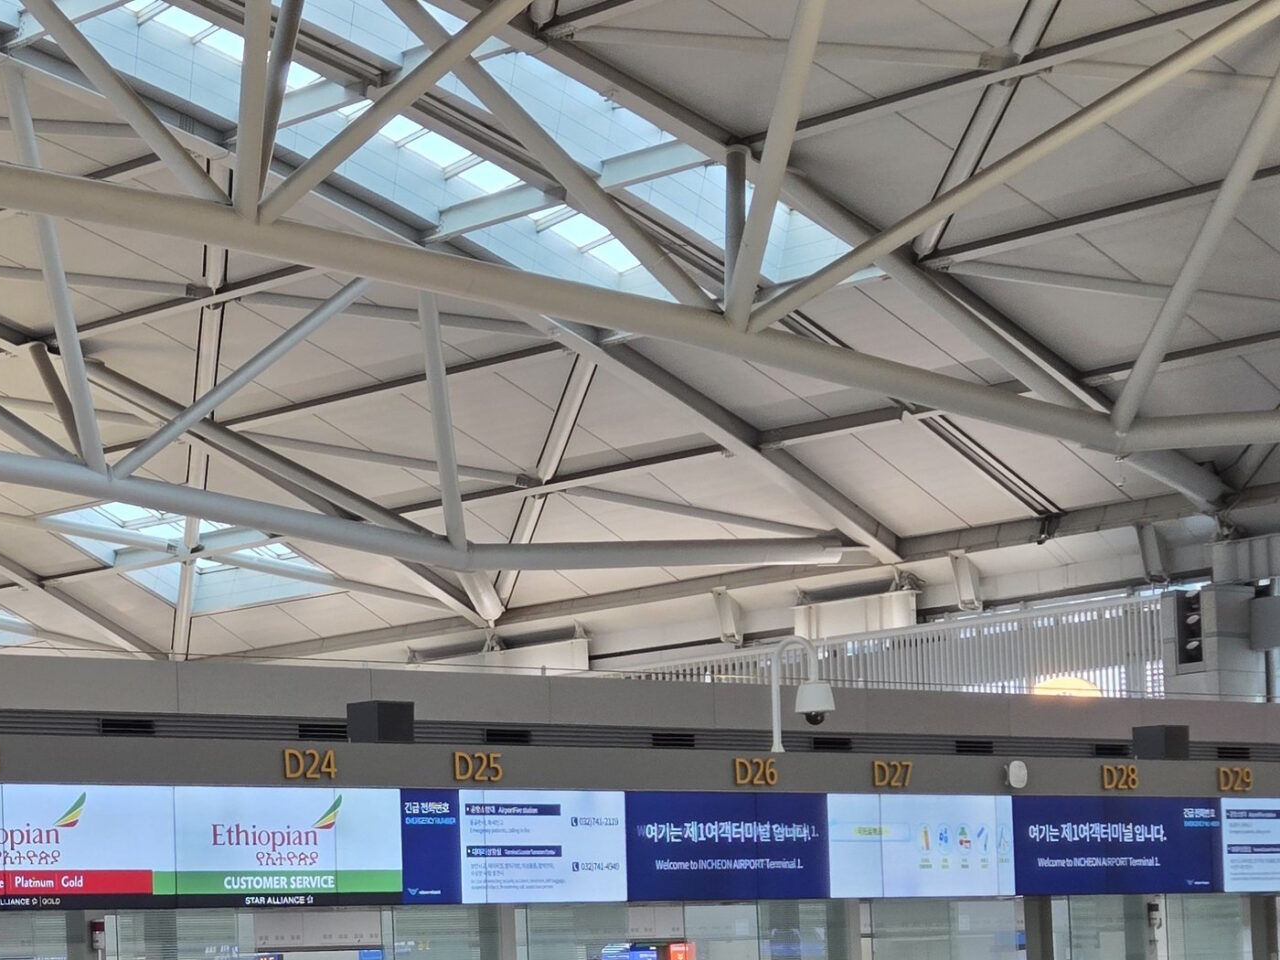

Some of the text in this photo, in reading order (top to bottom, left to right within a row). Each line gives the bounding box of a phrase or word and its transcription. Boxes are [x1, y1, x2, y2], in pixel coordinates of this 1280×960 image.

[283, 749, 338, 780] D24
[453, 752, 503, 782] D25
[734, 757, 779, 786] D26
[873, 761, 913, 788] D27
[1102, 765, 1140, 790] D28
[1218, 767, 1254, 791] D29
[212, 823, 318, 852] Ethiopian
[646, 821, 682, 843] 여기는
[1028, 822, 1167, 842] 여기는 제1여객터미널 입니다.
[655, 859, 690, 870] Welcome
[690, 861, 697, 869] to
[699, 860, 732, 869] INCHEON
[733, 860, 764, 869] AIRPORT
[1037, 857, 1065, 867] Welcome
[15, 876, 55, 888] Platinum
[61, 875, 84, 888] Gold
[223, 875, 335, 889] CUSTOMER SERVICE
[42, 897, 61, 905] GOLD
[245, 896, 305, 905] STAR ALLIANCE
